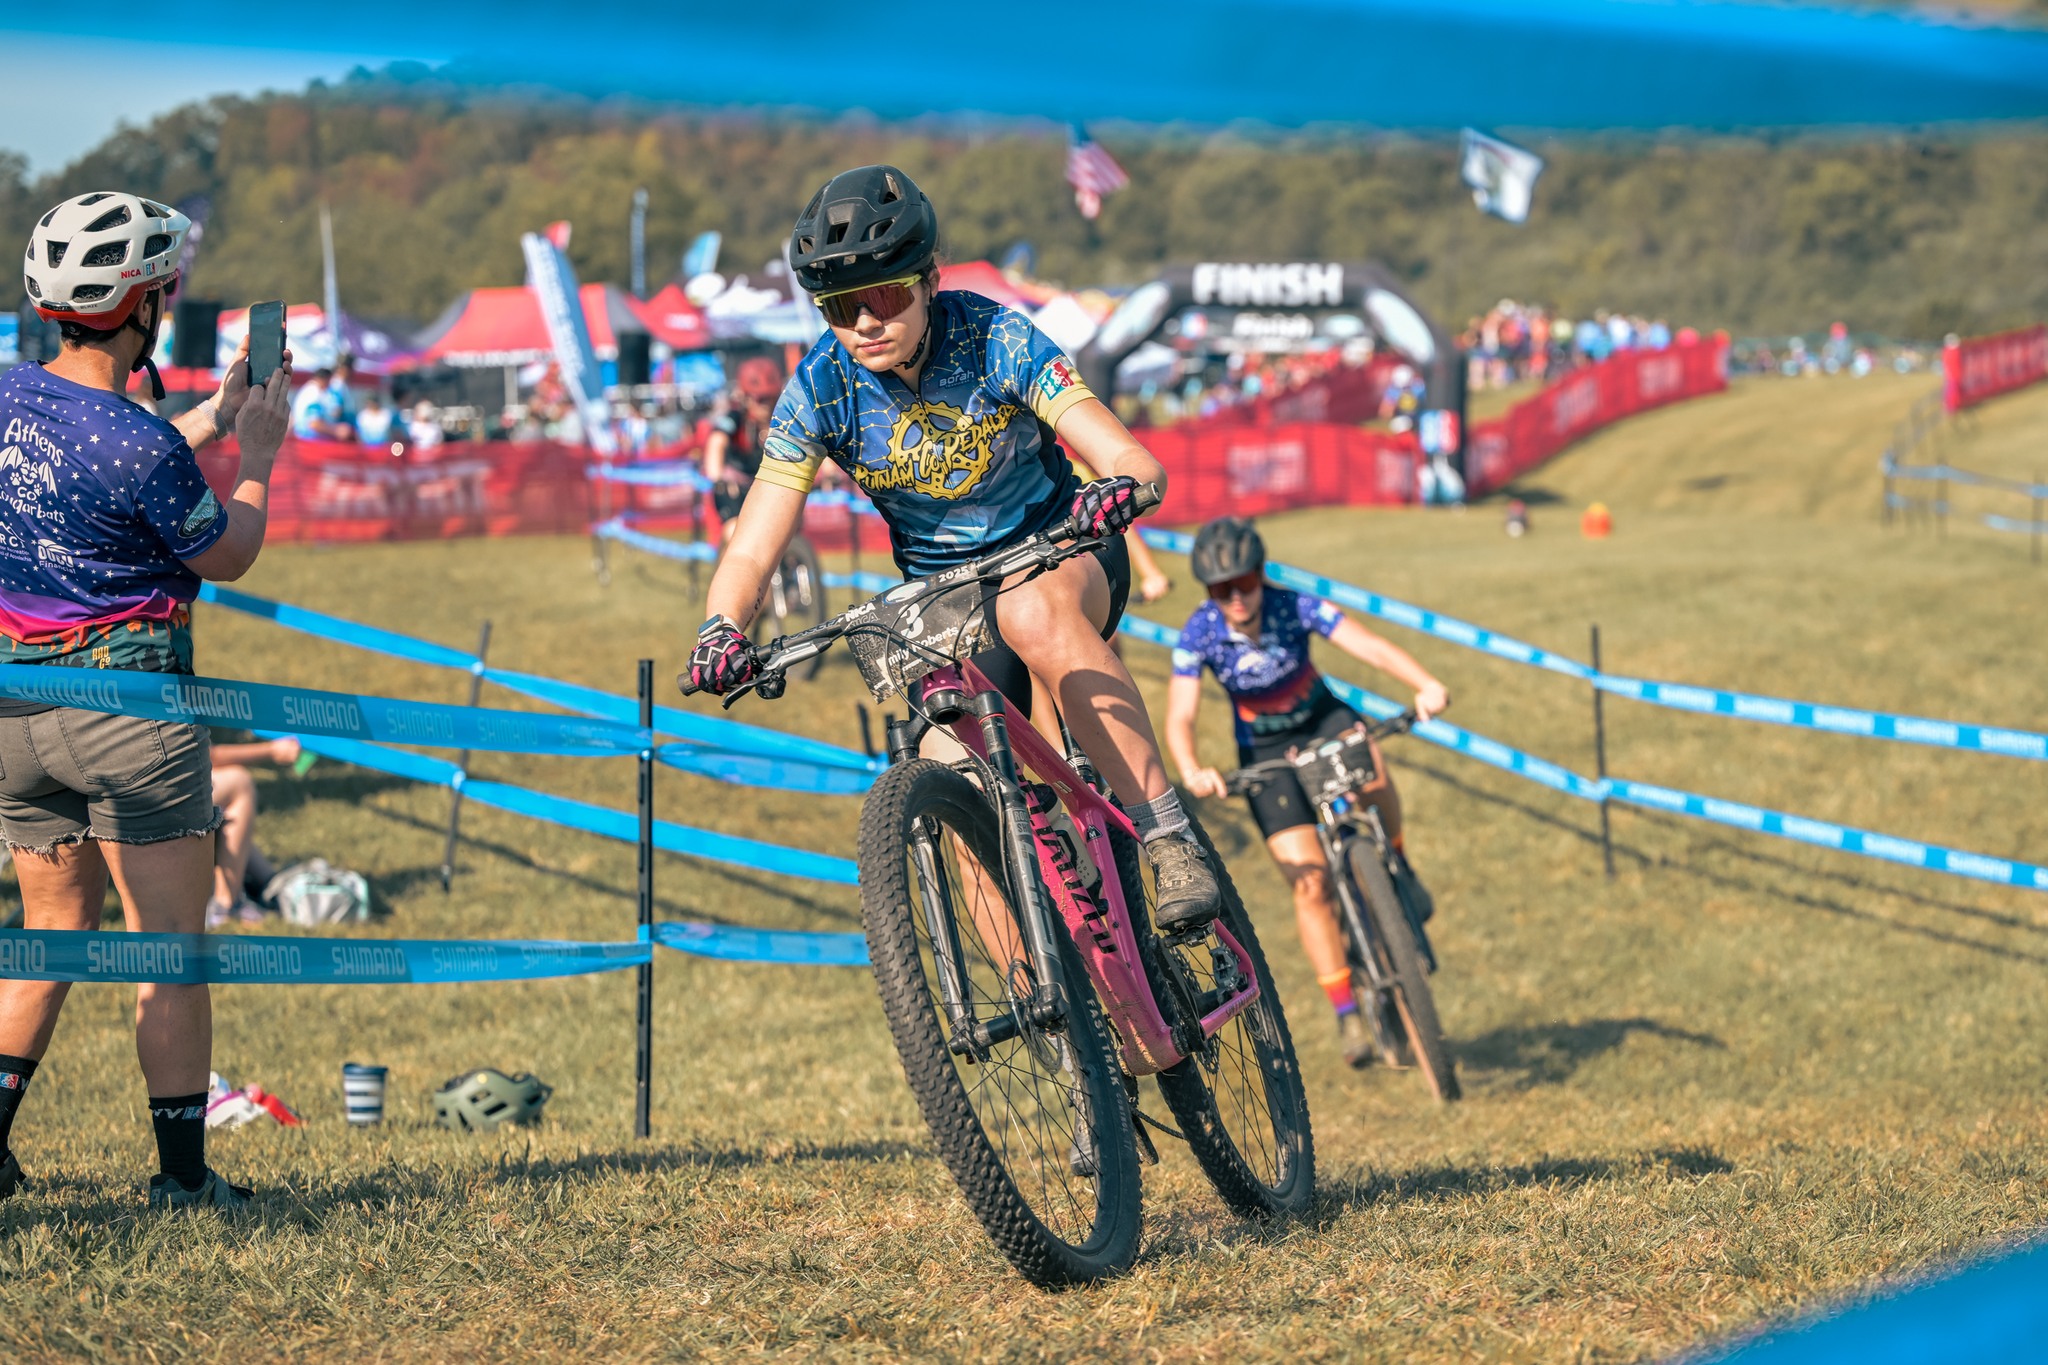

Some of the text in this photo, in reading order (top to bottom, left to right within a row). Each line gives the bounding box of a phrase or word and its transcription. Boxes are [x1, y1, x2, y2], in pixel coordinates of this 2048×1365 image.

[120, 268, 142, 279] NICA
[1191, 262, 1344, 306] FINISH
[3, 417, 64, 467] Athens
[853, 459, 915, 491] PUTNAM
[39, 560, 76, 575] Financial
[938, 566, 969, 583] 2025
[845, 602, 876, 622] NICA
[898, 602, 925, 639] 3
[6, 675, 123, 710] SHIMANO
[161, 683, 253, 721] SHIMANO
[283, 695, 360, 732] SHIMANO
[386, 707, 454, 739] SHIMANO
[476, 716, 538, 747] SHIMANO
[87, 940, 184, 975] SHIMANO
[217, 943, 302, 976] SHIMANO
[332, 946, 406, 976] SHIMANO
[432, 946, 498, 973] SHIMANO
[1086, 998, 1108, 1039] FAST
[1101, 1044, 1121, 1086] TRAK
